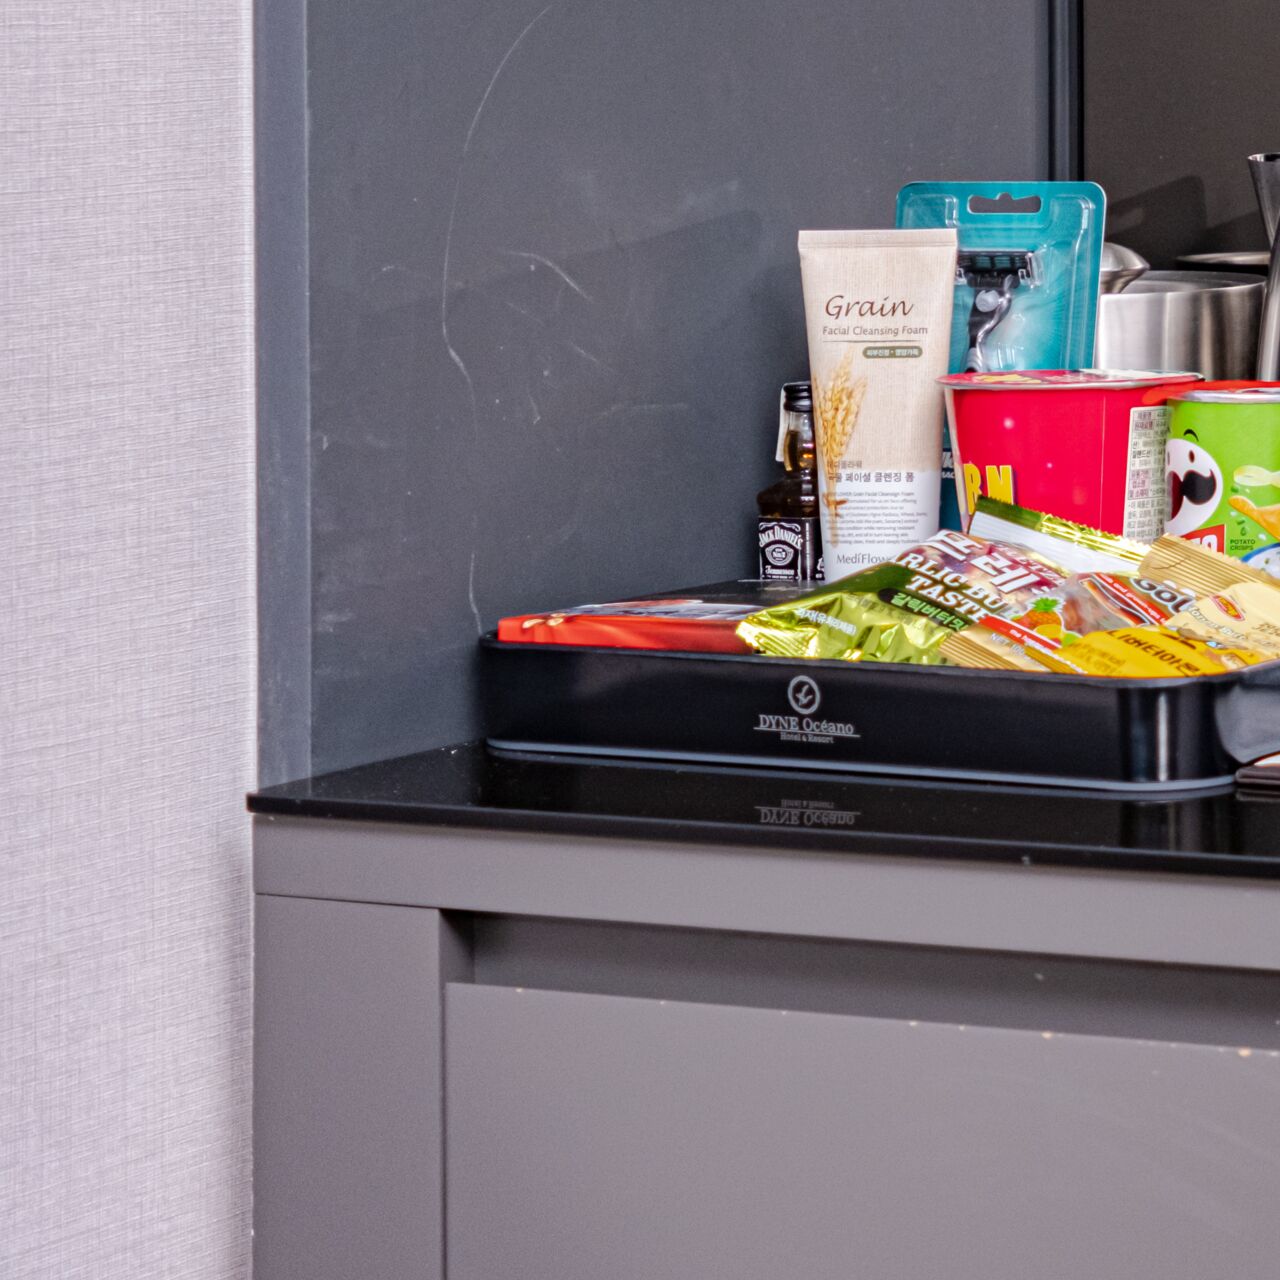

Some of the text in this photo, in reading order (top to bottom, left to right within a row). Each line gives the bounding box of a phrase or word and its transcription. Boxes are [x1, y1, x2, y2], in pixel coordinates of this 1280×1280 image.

[825, 295, 914, 320] Grain
[822, 325, 928, 336] Facial Cleansing Foam
[758, 714, 854, 735] DYNE Océano
